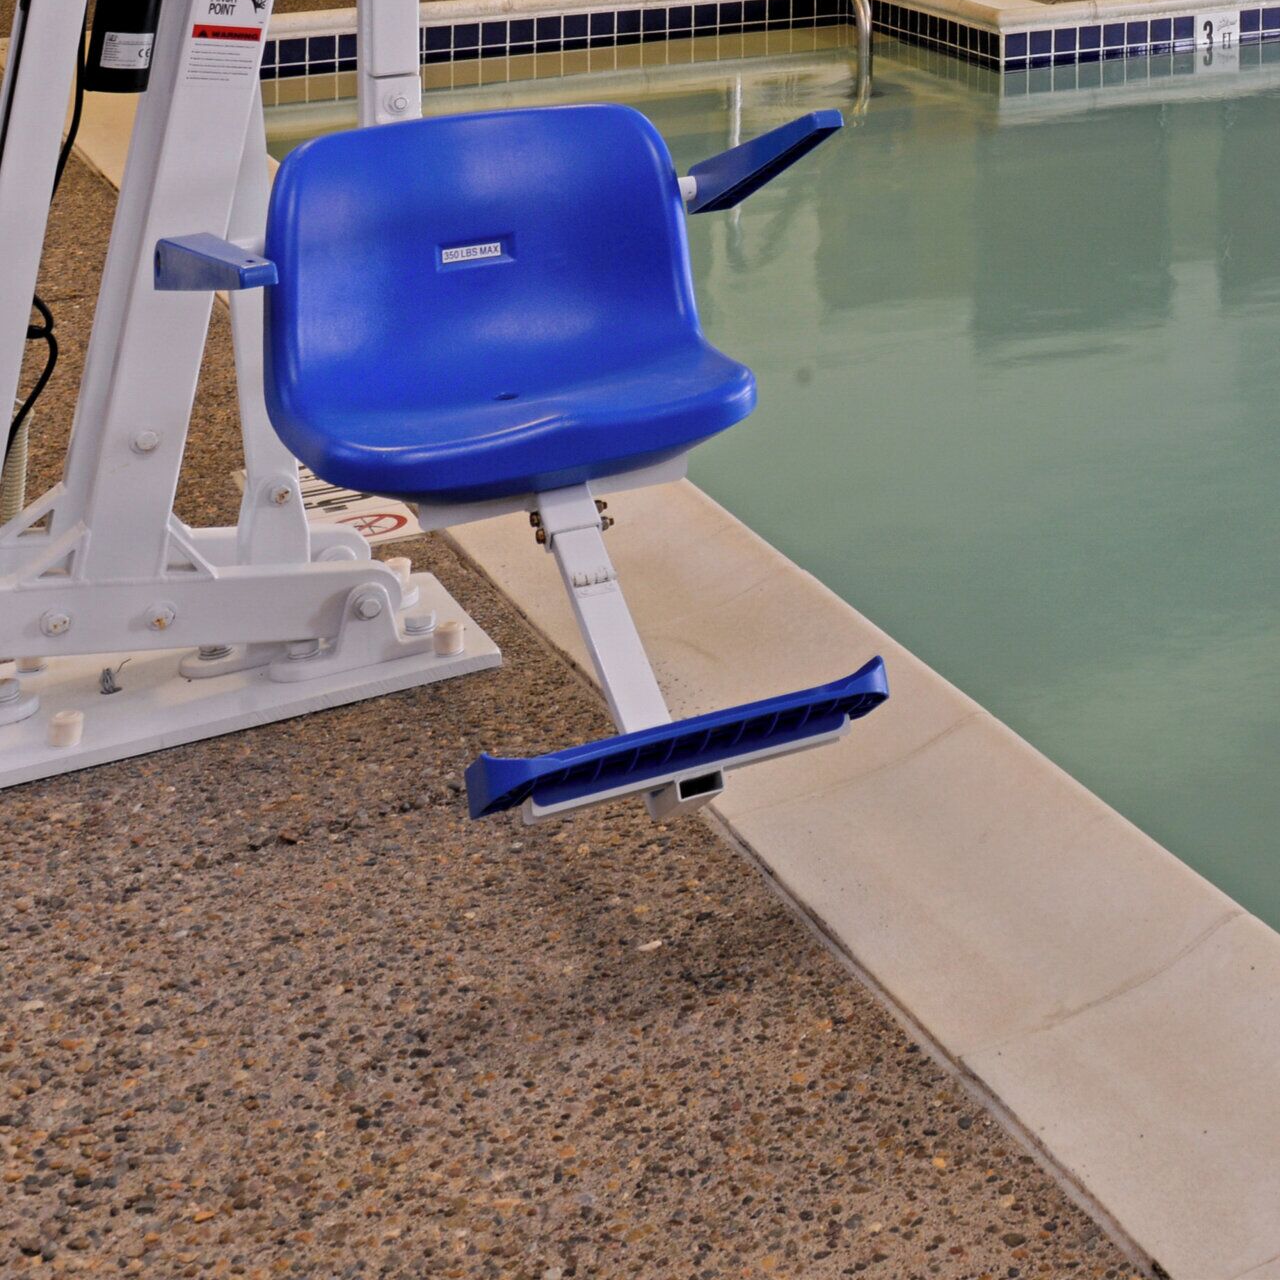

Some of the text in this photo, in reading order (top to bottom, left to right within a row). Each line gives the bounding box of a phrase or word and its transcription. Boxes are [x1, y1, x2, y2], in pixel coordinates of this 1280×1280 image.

[208, 3, 237, 16] POINT
[211, 31, 258, 40] WARNING
[1203, 20, 1214, 44] 3
[460, 247, 478, 258] LBS
[479, 244, 499, 255] MAX
